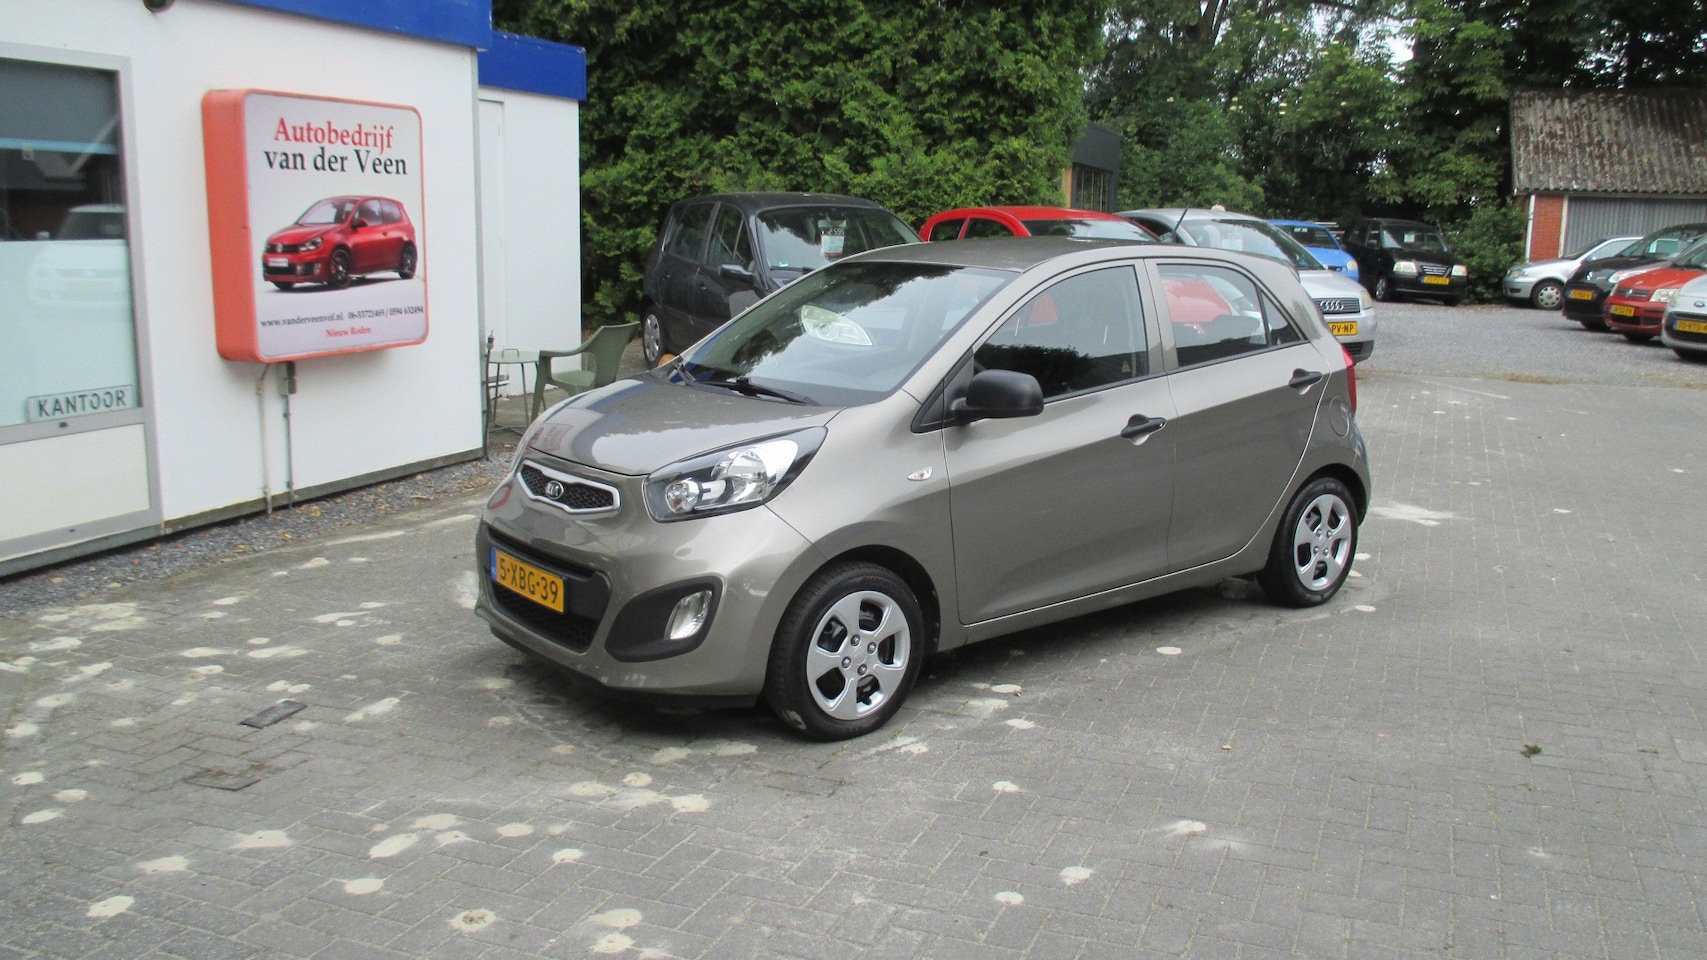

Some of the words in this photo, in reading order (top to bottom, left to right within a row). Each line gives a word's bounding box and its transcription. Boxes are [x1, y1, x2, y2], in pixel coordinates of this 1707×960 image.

[274, 117, 394, 155] Autobedrijf
[264, 150, 306, 171] van
[313, 147, 348, 172] der
[354, 149, 407, 175] Veen
[260, 312, 343, 327] www.vanderveenvof.nl
[326, 327, 349, 338] Nieuw
[350, 325, 372, 336] Roden
[38, 390, 127, 417] KANTOOR
[500, 557, 558, 604] 5-XBG-39
